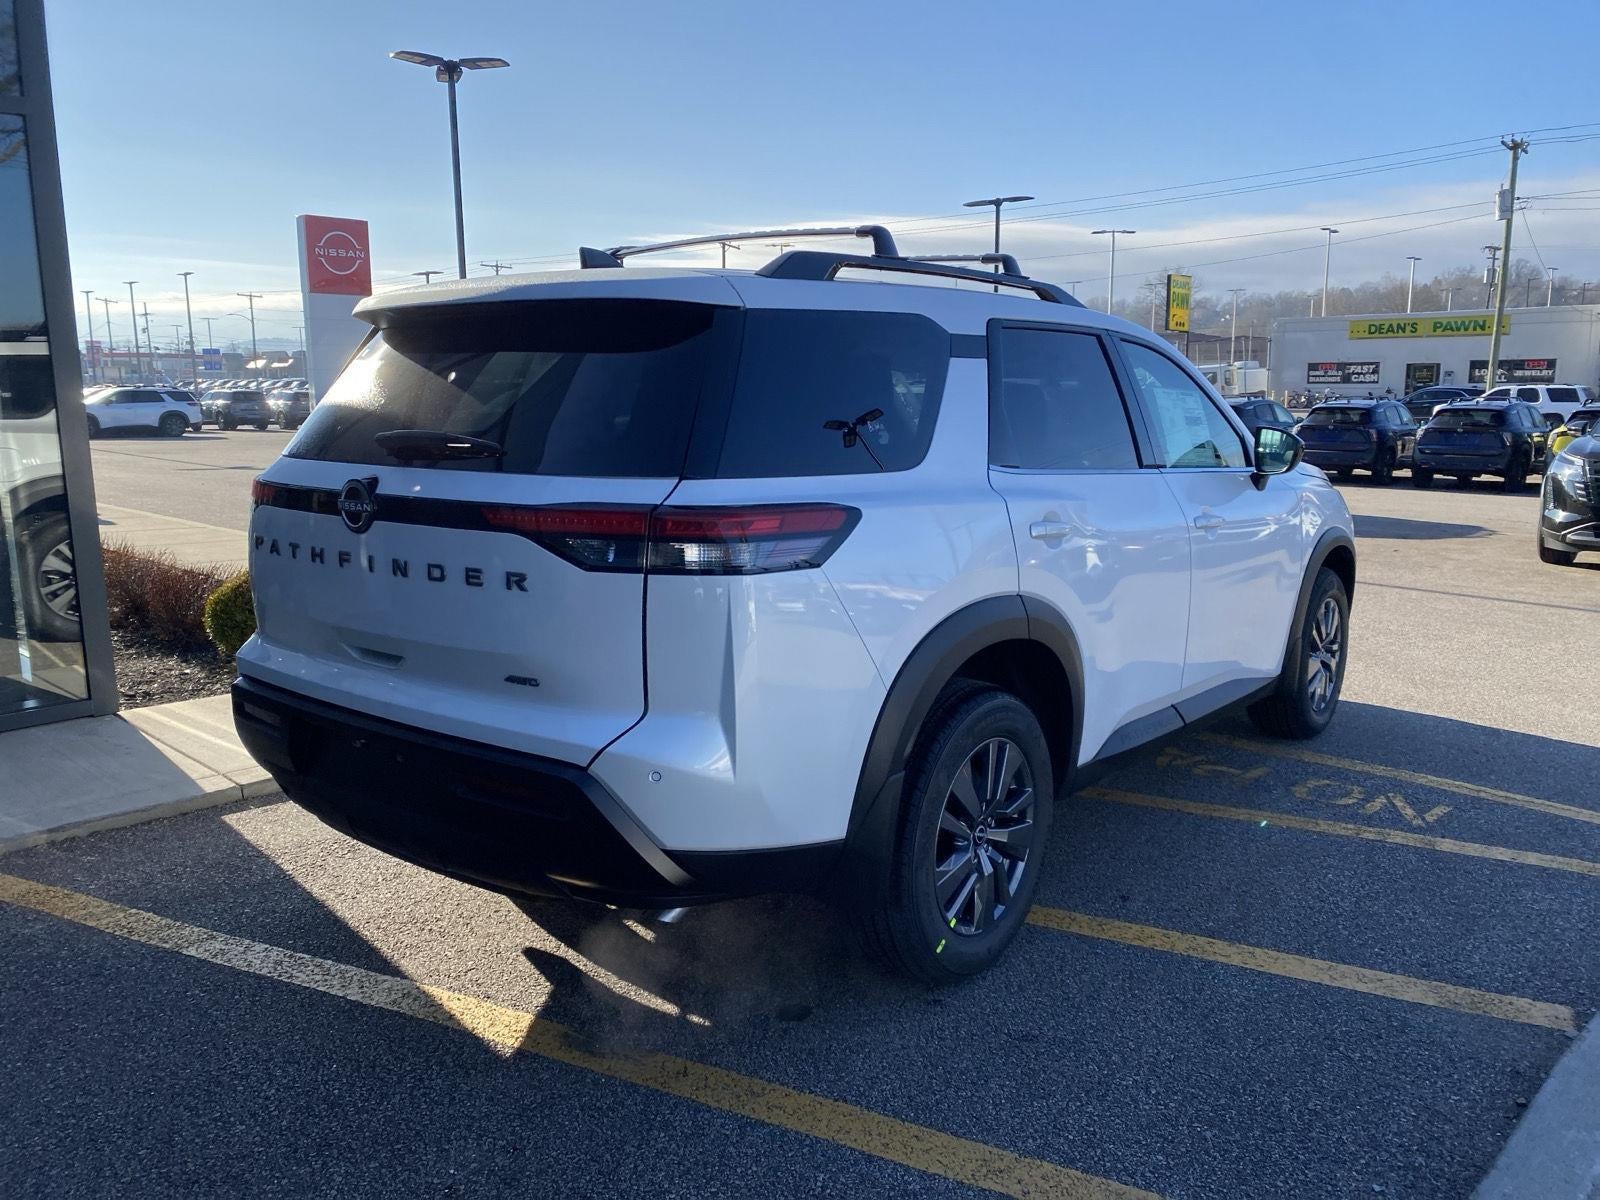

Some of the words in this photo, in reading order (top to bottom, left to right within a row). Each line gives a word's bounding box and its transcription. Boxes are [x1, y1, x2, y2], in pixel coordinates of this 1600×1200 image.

[314, 247, 365, 258] NISSAN
[1350, 365, 1376, 373] FAST
[1513, 369, 1554, 377] JEWELRY
[1351, 374, 1378, 383] CASH
[337, 500, 372, 512] NISSAN
[254, 534, 529, 592] PATHFINDER
